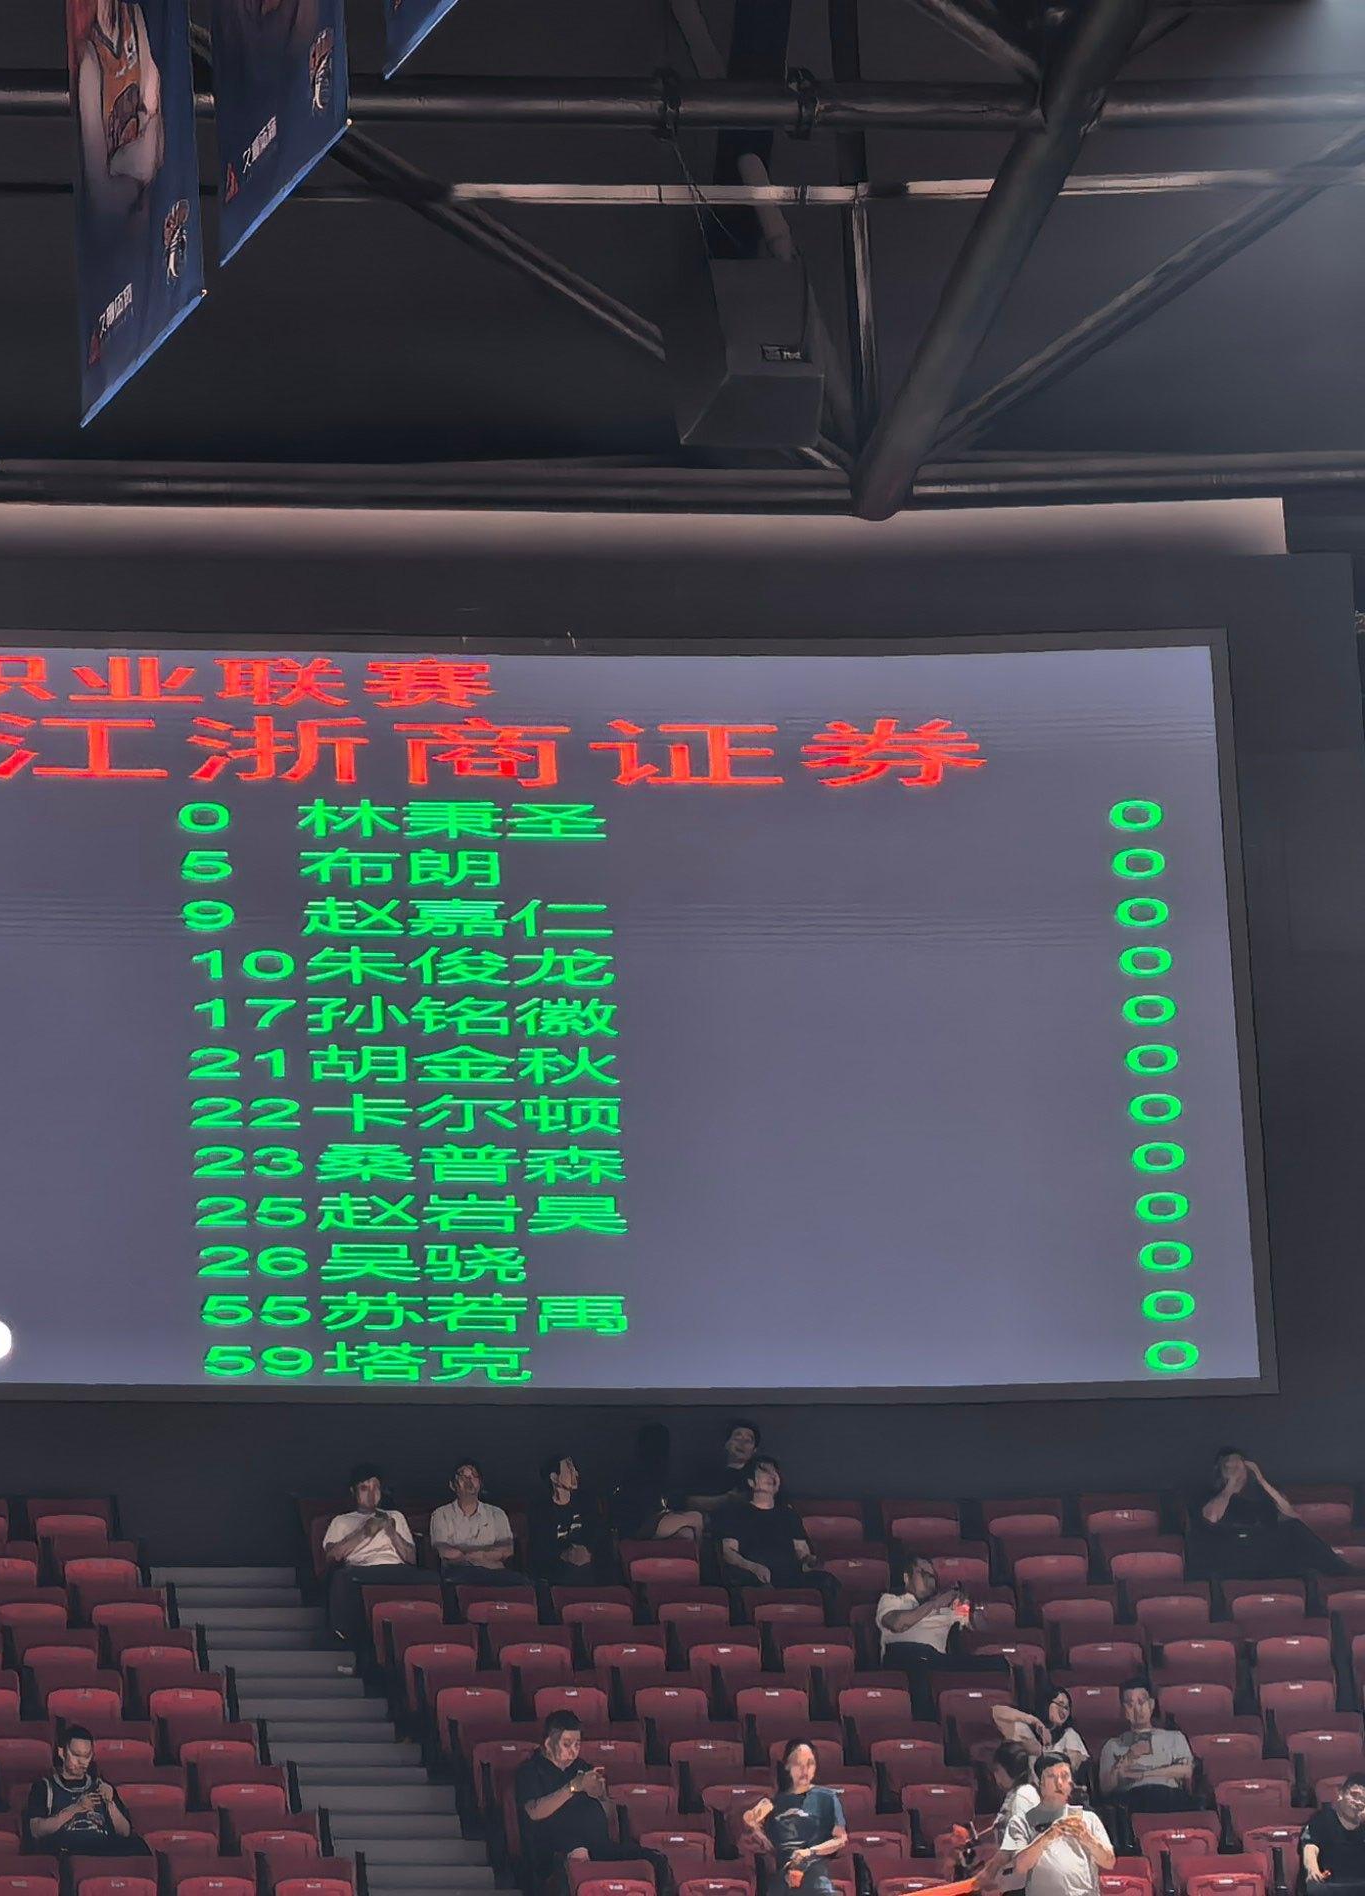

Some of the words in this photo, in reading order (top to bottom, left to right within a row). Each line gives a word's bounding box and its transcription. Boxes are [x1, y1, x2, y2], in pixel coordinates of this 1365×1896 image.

[177, 800, 232, 834] 0
[297, 798, 607, 841] 林秉圣
[1109, 799, 1164, 833] 0
[180, 850, 233, 882] 5
[299, 847, 501, 889] 布朗
[1111, 847, 1166, 880] 0
[181, 900, 235, 932] 9
[301, 896, 614, 939] 赵嘉仁
[1115, 897, 1169, 929] 0
[192, 948, 297, 981] 10
[305, 945, 617, 989] 朱俊龙
[1118, 946, 1173, 979] 0
[194, 997, 298, 1030] 17
[1121, 995, 1178, 1027] 0
[188, 1046, 287, 1080] 21
[309, 1043, 620, 1087] 胡金秋
[1124, 1044, 1179, 1077] 0
[190, 1095, 302, 1130] 22
[312, 1093, 622, 1136] 卡尔顿
[1128, 1093, 1183, 1126] 0
[192, 1145, 306, 1180] 23
[315, 1142, 626, 1187] 桑普森
[1131, 1141, 1187, 1174] 0
[195, 1194, 309, 1229] 25
[317, 1191, 629, 1235] 赵岩昊
[1135, 1192, 1190, 1225] 0
[197, 1244, 311, 1280] 26
[320, 1242, 528, 1285] 吴骁
[1139, 1240, 1194, 1274] 0
[200, 1294, 313, 1328] 55
[321, 1291, 630, 1335] 苏若禹
[1141, 1290, 1196, 1323] 0
[203, 1344, 316, 1379] 59
[322, 1341, 532, 1386] 塔克
[1144, 1340, 1199, 1373] 0
